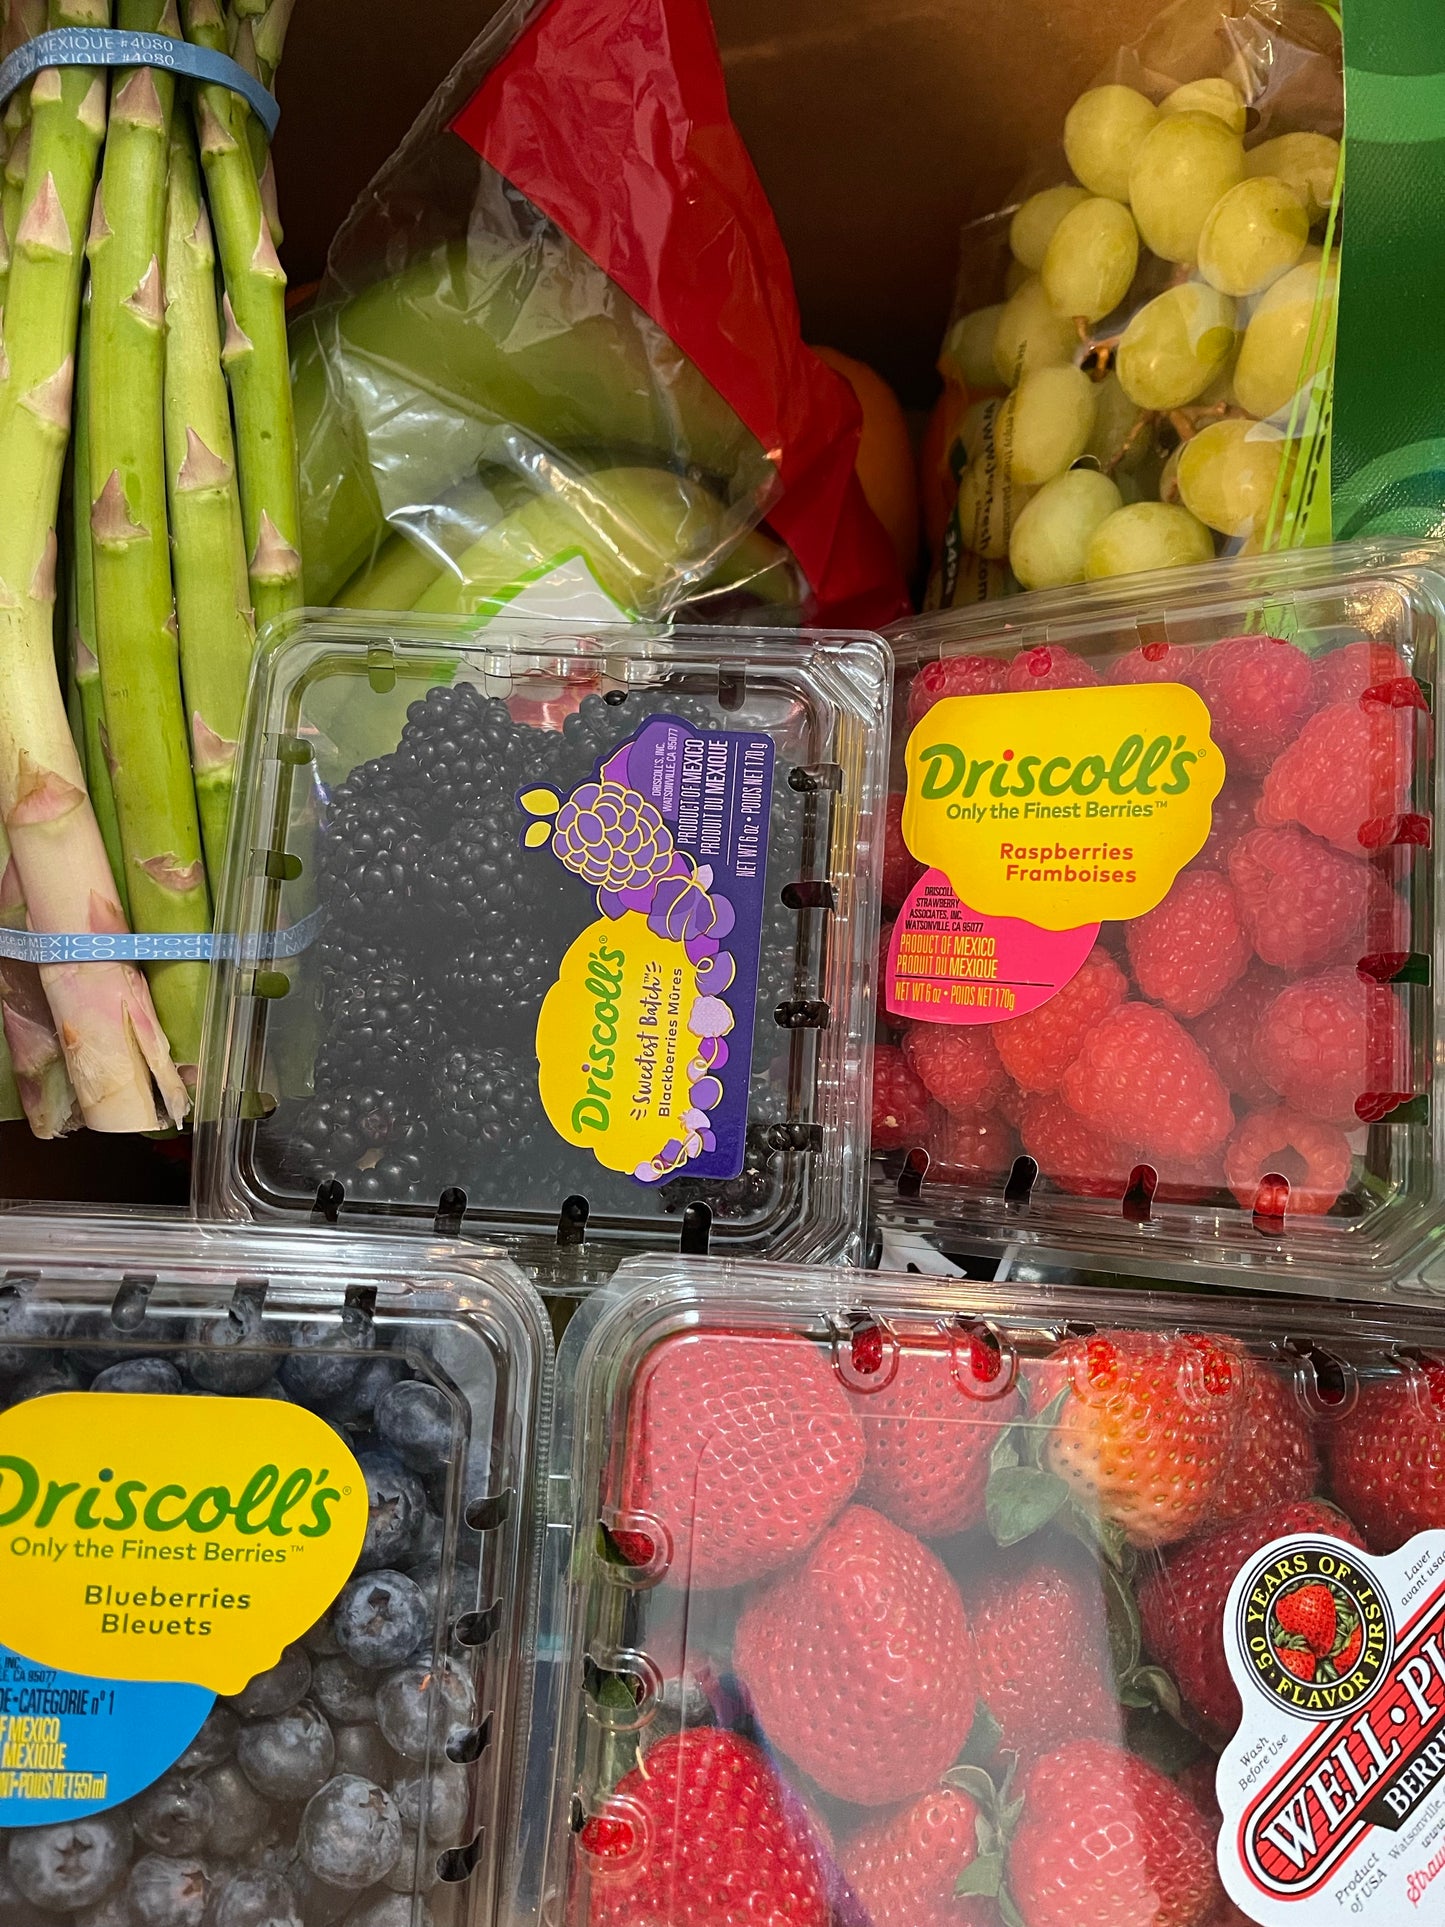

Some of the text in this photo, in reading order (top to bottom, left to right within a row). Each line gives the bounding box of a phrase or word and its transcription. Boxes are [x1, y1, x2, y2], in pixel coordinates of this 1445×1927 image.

[37, 36, 173, 53] MEXIQUE #4080
[37, 52, 174, 66] MEXIQUE #4080
[656, 742, 665, 756] INC.
[663, 728, 678, 812] WATSONVILLE CA 95077
[743, 768, 763, 786] NET
[678, 739, 704, 844] PRODUCT OF MEXICO
[700, 740, 728, 855] PRODUIT DU MEXIQUE
[741, 788, 762, 814] POIDS
[946, 802, 988, 823] Only
[989, 802, 1019, 820] the
[1024, 802, 1082, 820] Finest
[748, 825, 759, 835] oz
[738, 843, 758, 858] WT
[1000, 843, 1134, 863] Raspberries
[736, 860, 756, 878] NET
[1006, 864, 1137, 883] Framboises
[916, 898, 960, 909] STRAWBERRY
[952, 922, 961, 932] CA
[962, 922, 984, 932] 95077
[18, 936, 26, 946] of
[28, 936, 116, 948] MEXICO
[29, 948, 116, 960] MEXICO
[900, 934, 995, 957] PRODUCT OF MEXICO
[896, 954, 998, 979] PRODUIT DU MEXIQUE
[895, 982, 910, 1001] NET
[912, 983, 925, 1002] WT
[926, 984, 931, 1003] 6
[932, 988, 941, 1004] oz
[950, 985, 975, 1006] POIDS
[977, 987, 994, 1007] NET
[659, 968, 682, 1117] Blackberries Mûres
[633, 1031, 660, 1106] Sweetest
[10, 1536, 68, 1562] Only
[74, 1538, 114, 1559] the
[121, 1539, 197, 1561] Finest
[1404, 1550, 1431, 1581] Laver
[84, 1584, 251, 1610] Blueberries
[1401, 1574, 1427, 1606] avant
[101, 1613, 212, 1635] Bleuets
[1247, 1553, 1386, 1709] 50 YEARS OF FLAVOR FIRST
[13, 1669, 25, 1682] CA
[29, 1670, 57, 1682] 95077
[8, 1716, 60, 1743] MEXICO
[2, 1742, 67, 1770] MEXIQUE
[1238, 1734, 1288, 1792] Before Use
[1240, 1737, 1269, 1766] Wash
[1335, 1851, 1380, 1905] Product
[1350, 1869, 1388, 1913] of USA
